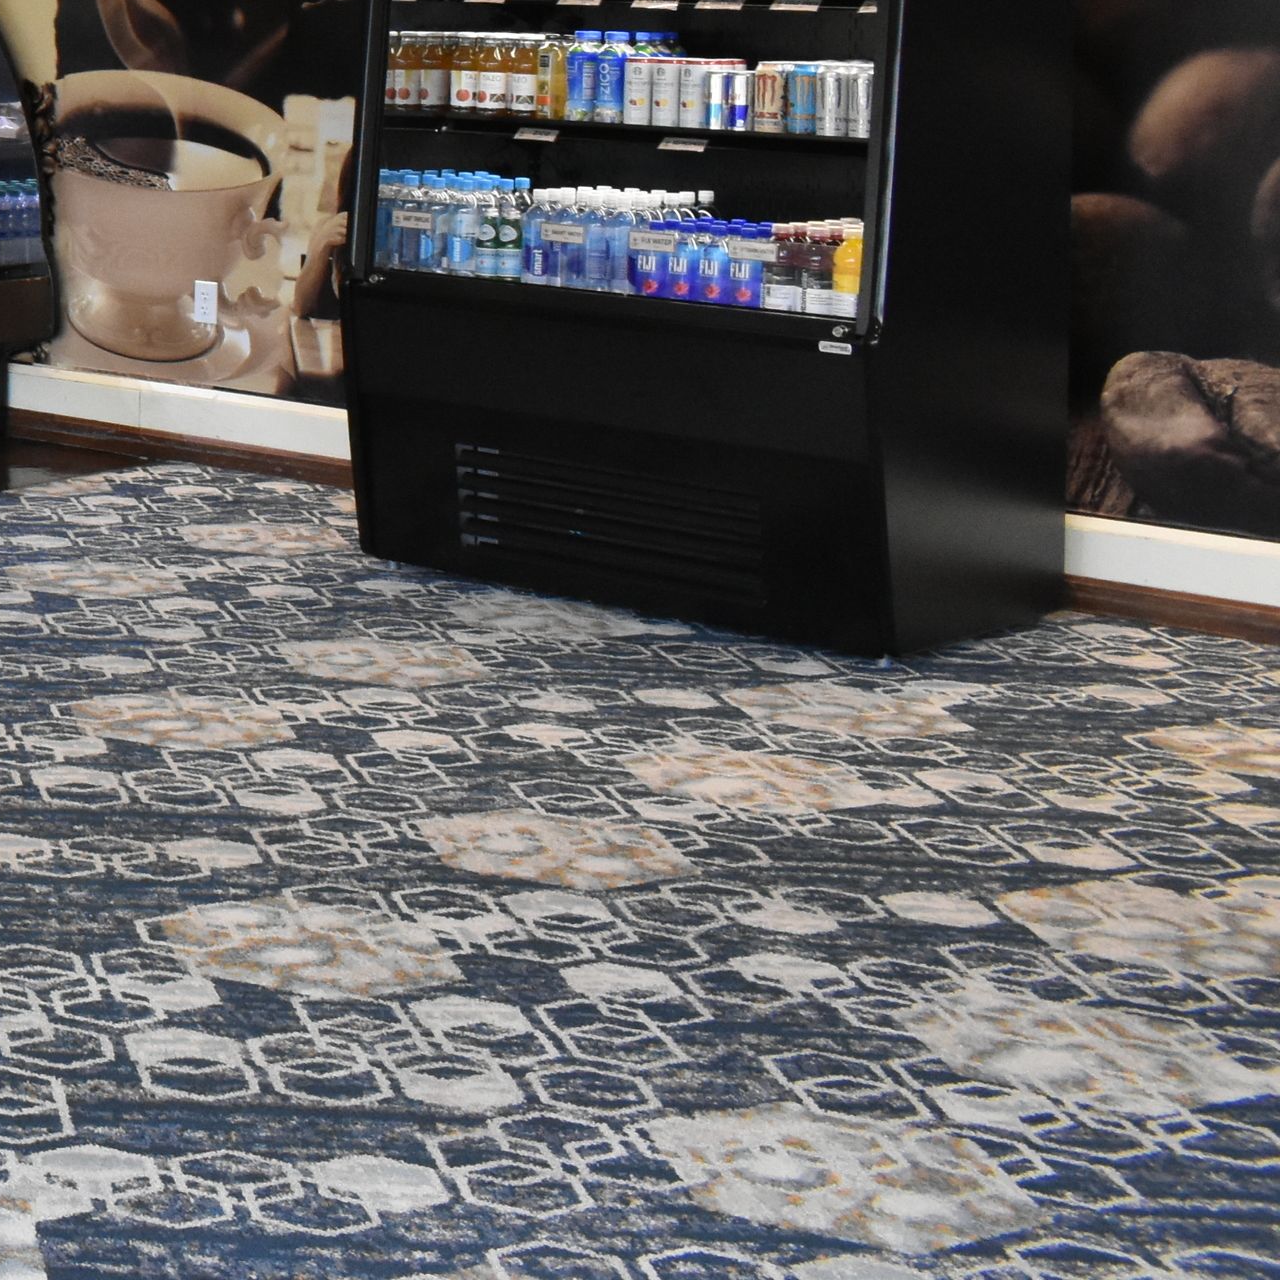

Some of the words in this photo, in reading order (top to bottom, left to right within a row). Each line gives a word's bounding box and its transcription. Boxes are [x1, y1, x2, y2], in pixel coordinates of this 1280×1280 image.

[599, 63, 610, 94] ZICO
[533, 249, 543, 276] smart
[637, 254, 656, 272] FIJI
[668, 256, 688, 274] FIJI
[699, 258, 718, 276] FIJI
[730, 263, 750, 280] FIJI
